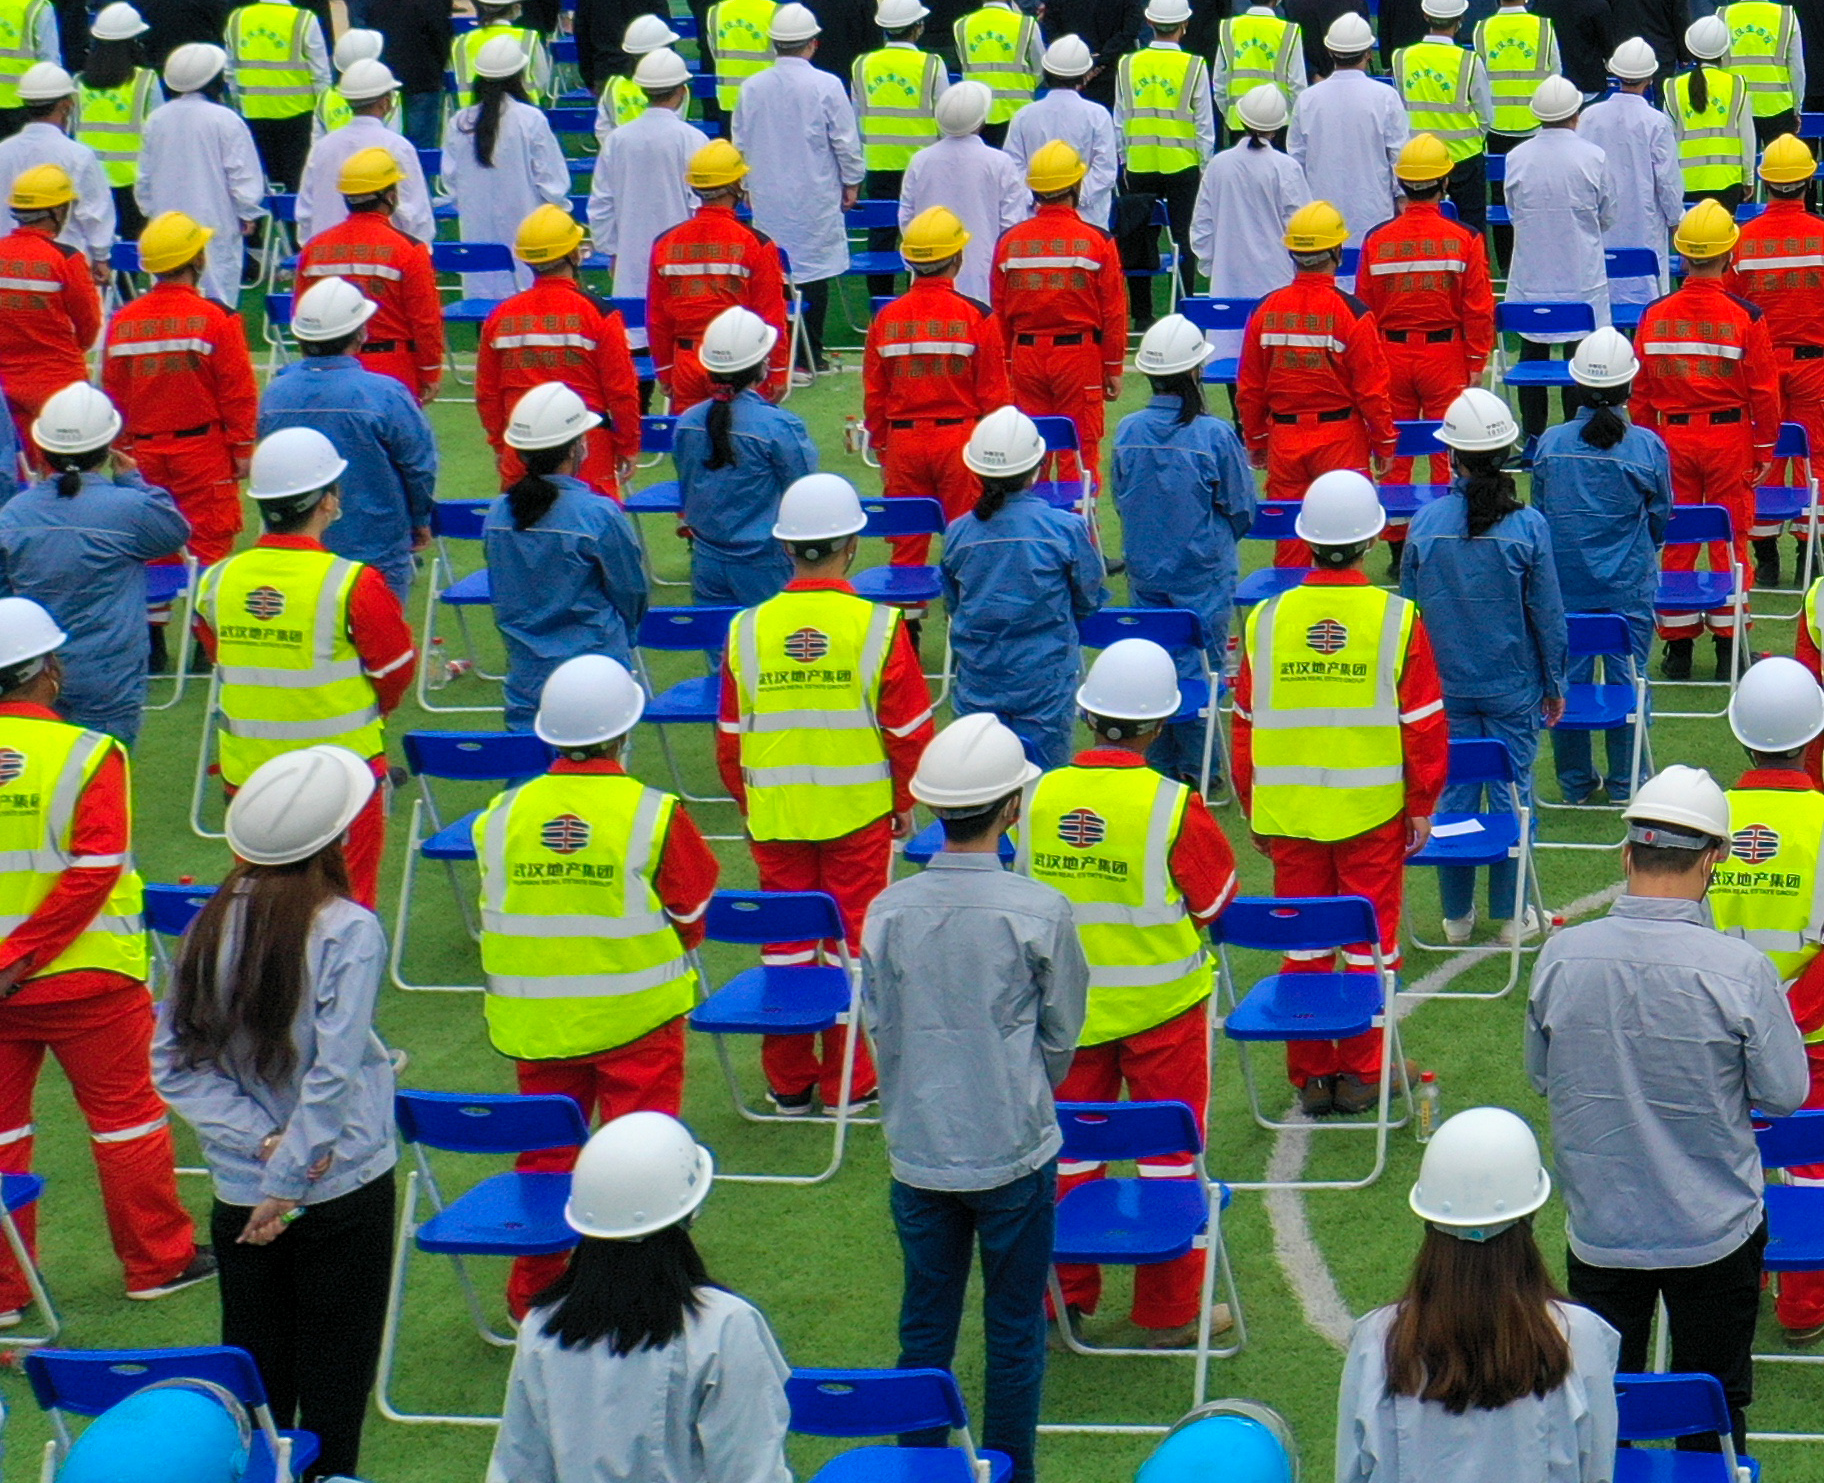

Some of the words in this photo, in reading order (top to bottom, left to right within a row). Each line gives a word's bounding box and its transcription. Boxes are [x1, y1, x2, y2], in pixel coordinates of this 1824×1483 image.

[220, 625, 304, 643] 武汉地产集团
[758, 669, 852, 685] 武汉地产集团
[1279, 661, 1367, 676] 武汉地产集团
[513, 862, 614, 879] 武汉地产集团
[1034, 853, 1128, 875] 武汉地产集团
